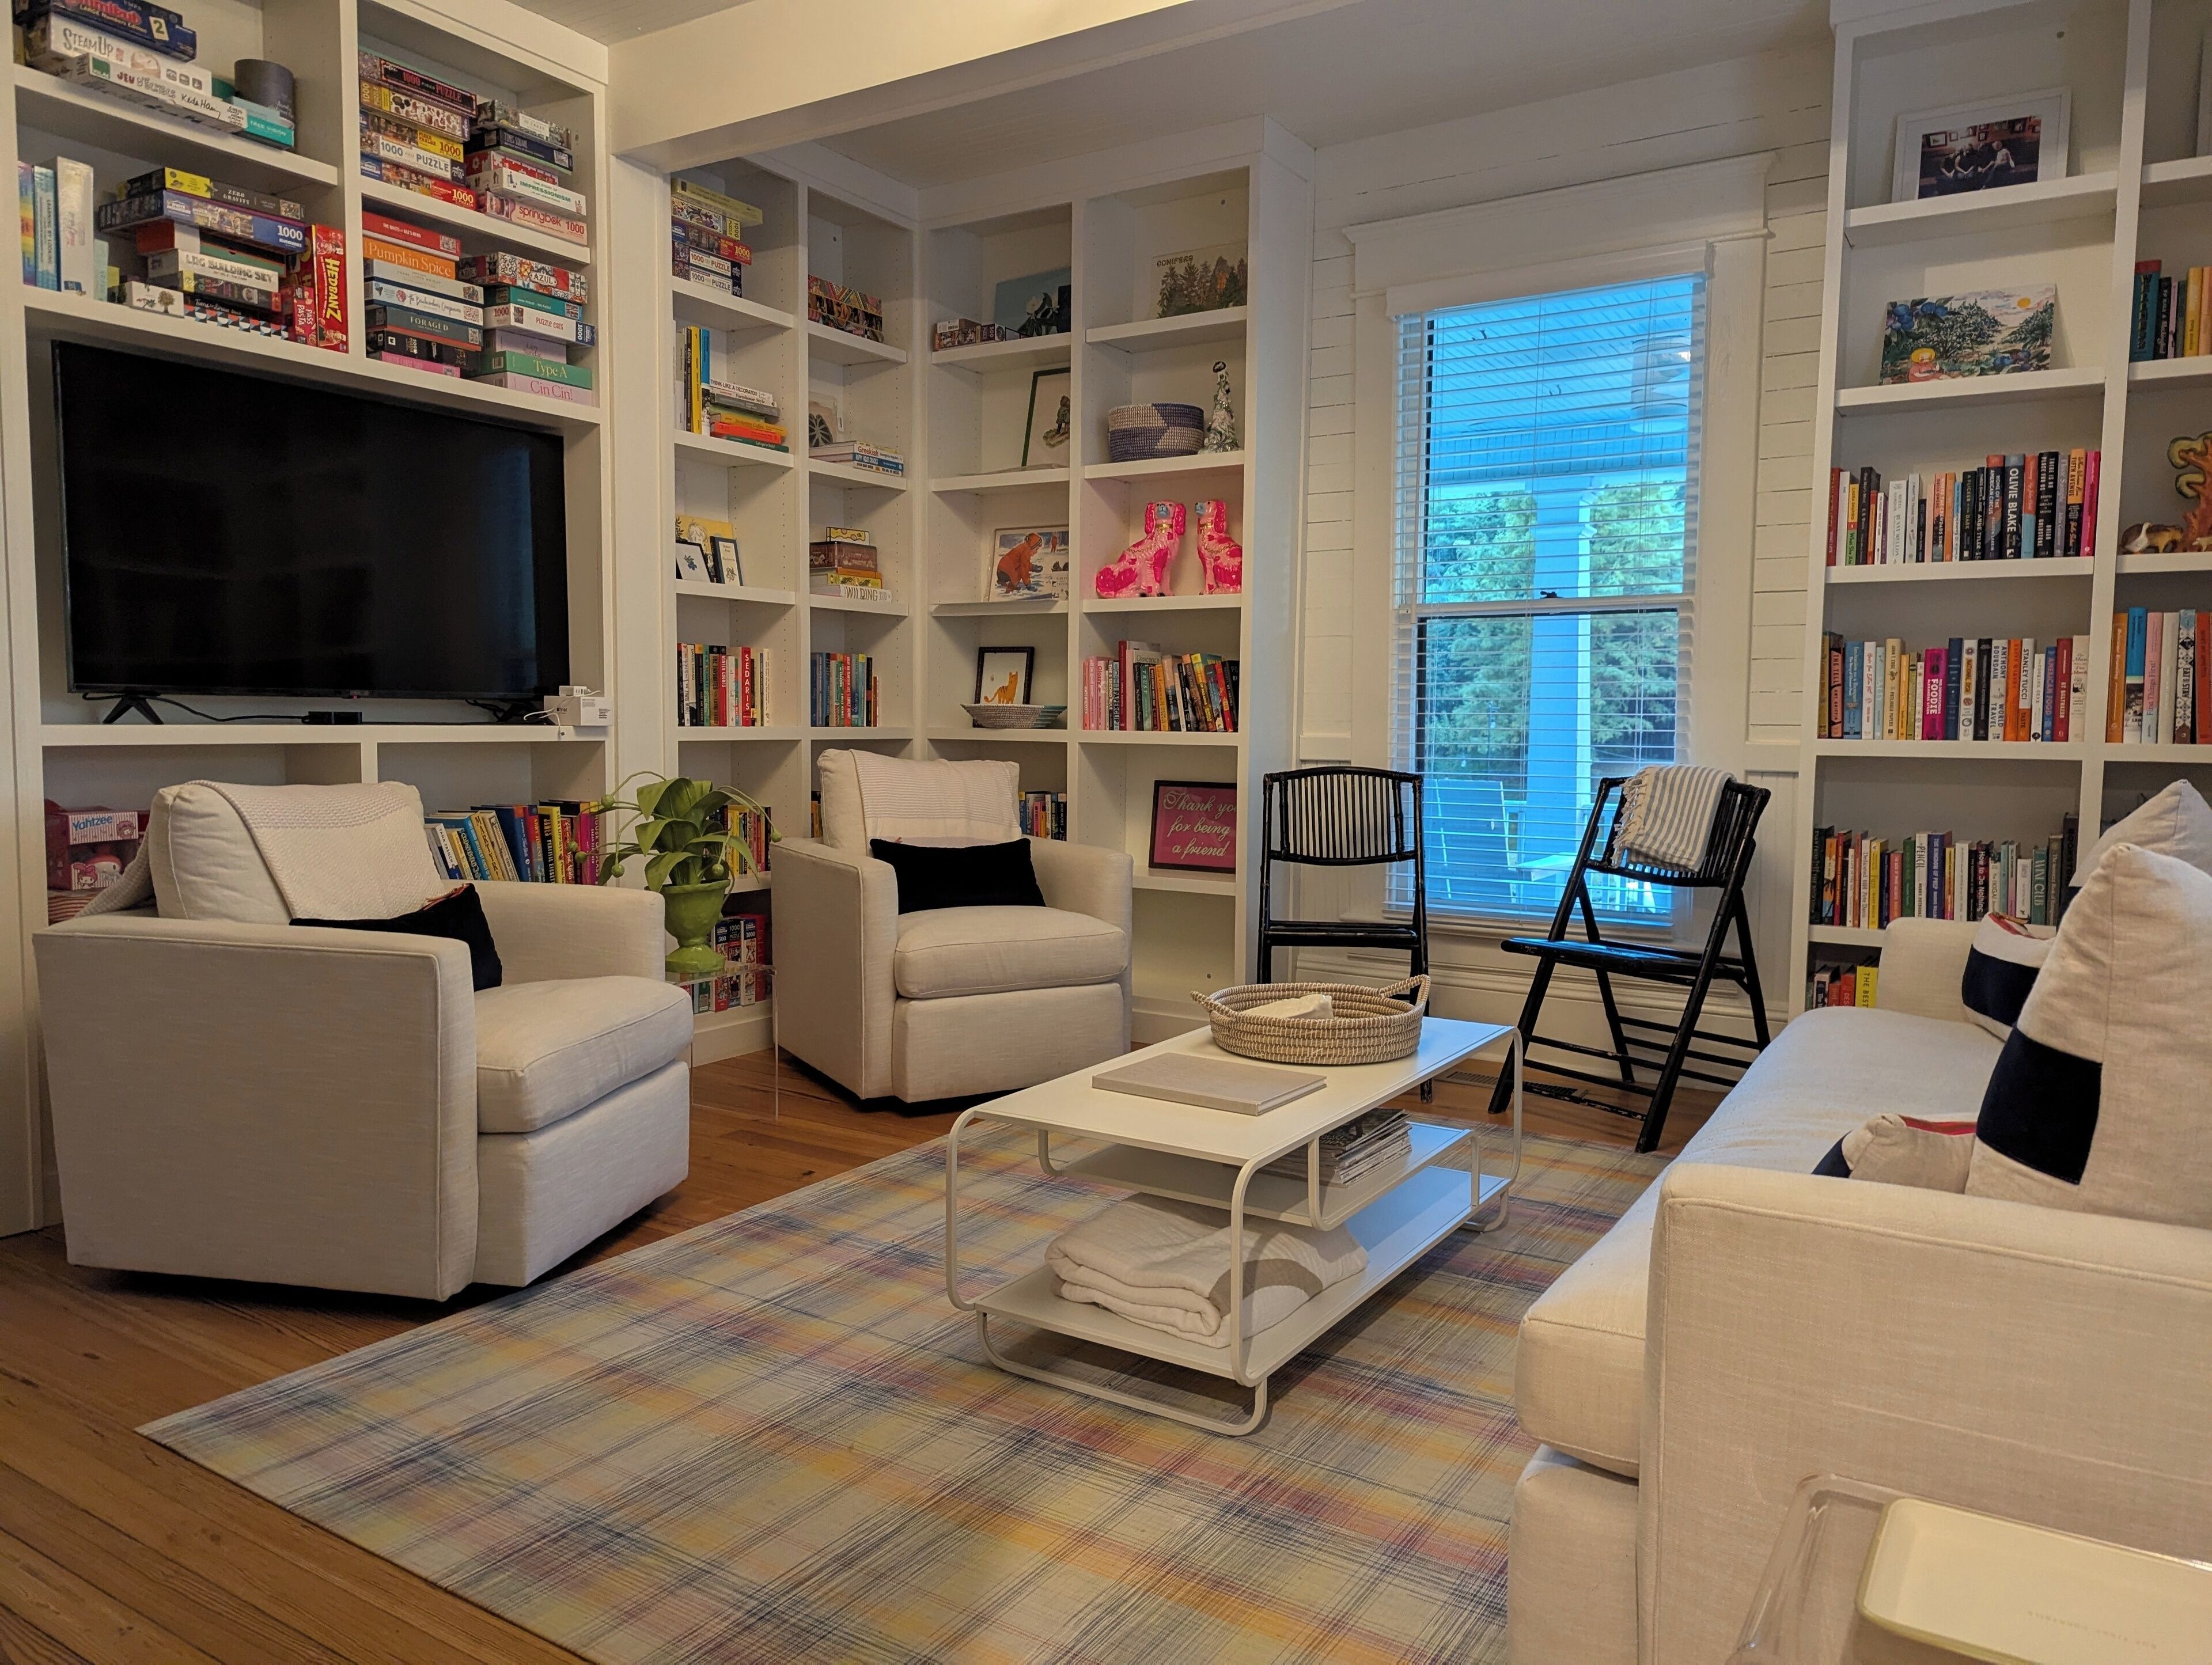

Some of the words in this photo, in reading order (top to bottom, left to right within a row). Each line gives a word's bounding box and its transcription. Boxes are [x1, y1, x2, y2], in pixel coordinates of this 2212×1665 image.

[153, 20, 165, 35] 2
[381, 142, 403, 156] 1000
[416, 153, 449, 172] PUZZLE
[440, 142, 460, 157] 1000
[228, 189, 245, 198] ZERO
[452, 189, 474, 204] 1000
[520, 181, 571, 202] IMPRESSIONISM
[520, 206, 561, 226] springbok
[277, 225, 303, 241] 1000
[566, 221, 584, 234] 1000
[369, 242, 419, 268] Pumpkin
[421, 259, 452, 276] Spice
[736, 246, 750, 257] 1000
[691, 254, 704, 263] 1000
[711, 260, 730, 271] PUZZLE
[534, 274, 553, 285] AZUL
[692, 272, 704, 282] 1000
[712, 279, 730, 291] PUZZLE
[494, 307, 509, 317] 1000
[410, 317, 448, 331] FORAGED
[533, 359, 558, 377] Type
[560, 365, 567, 378] A
[531, 380, 550, 395] Cin
[552, 385, 573, 400] Cin!
[2009, 468, 2018, 498] OLIVIE
[2007, 502, 2017, 532] BLAKE
[1930, 678, 1938, 714] FOODIE
[1164, 791, 1215, 811] Thank
[1215, 804, 1237, 819] yo
[73, 816, 112, 831] Yahtzee
[1167, 816, 1191, 837] for
[1194, 817, 1230, 841] being
[444, 844, 453, 863] FRENCH
[1172, 845, 1181, 853] a
[1181, 838, 1230, 859] friend
[1916, 846, 1926, 868] PENCIL
